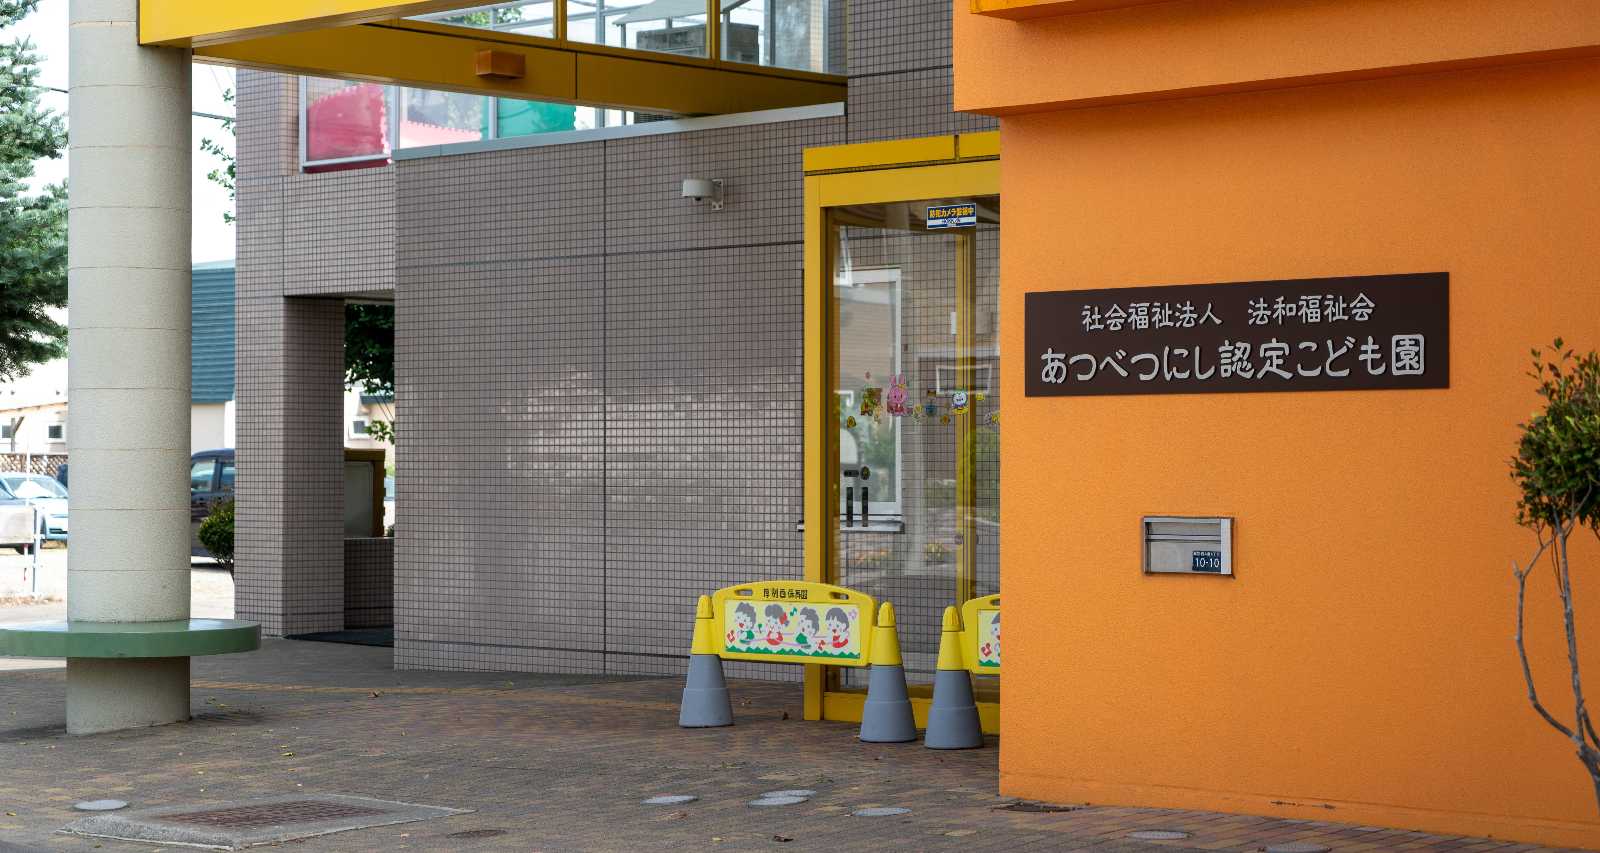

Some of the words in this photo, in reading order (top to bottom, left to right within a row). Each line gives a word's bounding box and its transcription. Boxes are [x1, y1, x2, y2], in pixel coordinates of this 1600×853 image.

[1081, 301, 1223, 332] 社会福祉法人
[1247, 292, 1376, 326] 法和福祉会
[1040, 333, 1425, 385] あつべつにし認定こども園
[1195, 557, 1220, 568] 10-10
